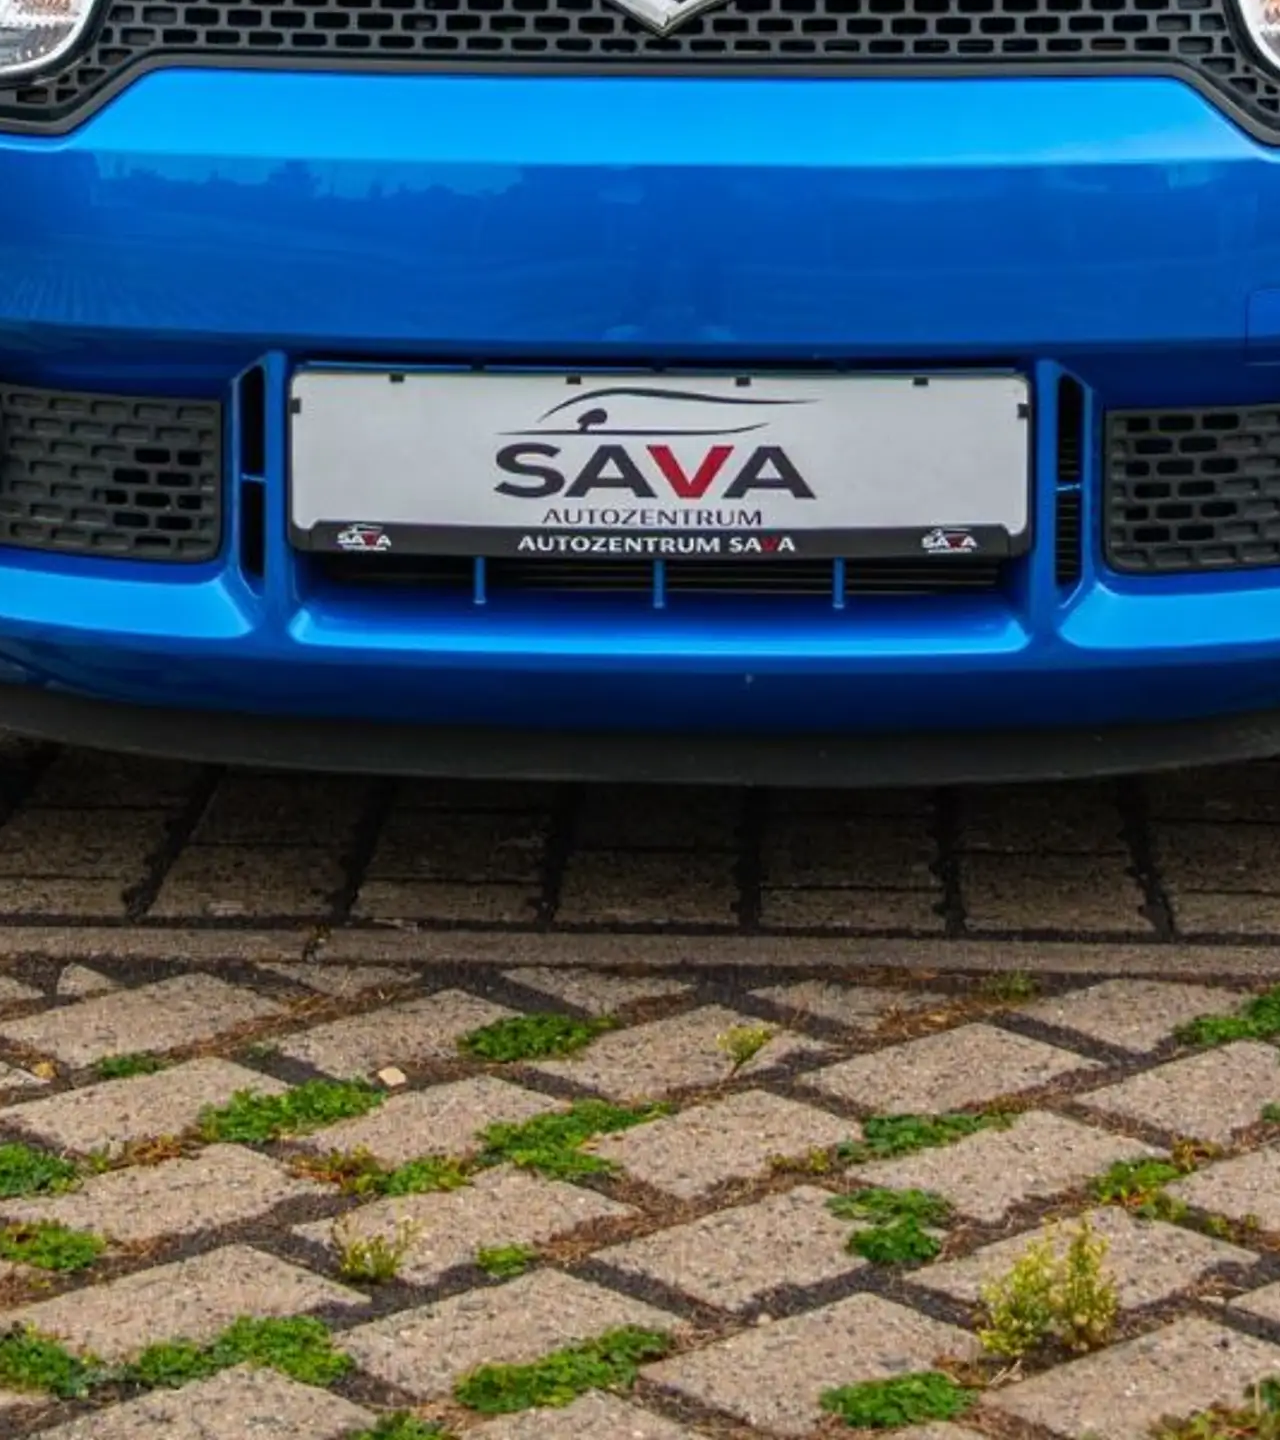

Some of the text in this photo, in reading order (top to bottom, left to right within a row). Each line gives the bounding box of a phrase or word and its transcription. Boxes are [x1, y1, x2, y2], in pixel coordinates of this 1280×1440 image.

[493, 441, 817, 501] SAVA
[541, 507, 763, 527] AUTOZENTRUM
[517, 534, 797, 554] AUTOZENTRUM SAVA
